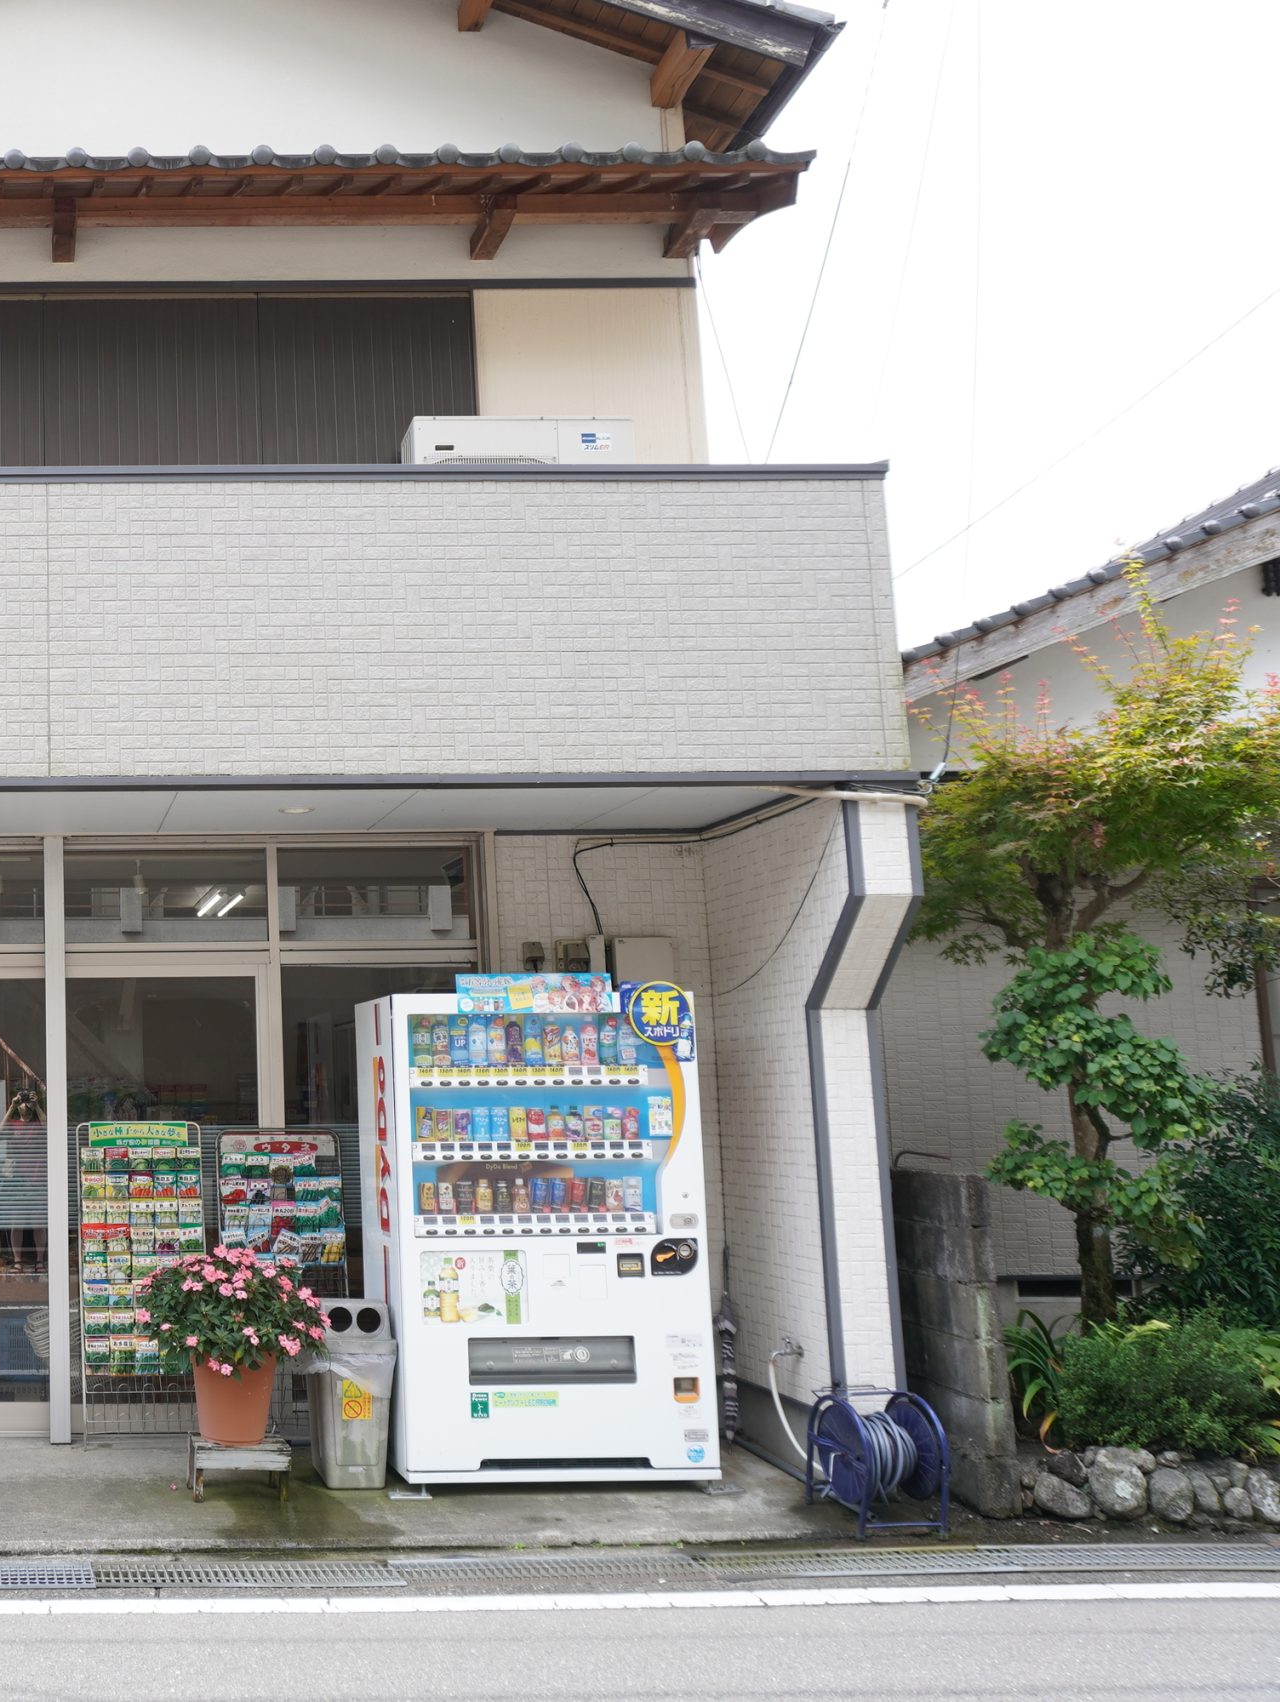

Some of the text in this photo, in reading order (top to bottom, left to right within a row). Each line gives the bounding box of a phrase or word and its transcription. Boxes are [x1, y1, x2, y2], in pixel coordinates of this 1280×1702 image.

[641, 989, 680, 1026] 新
[454, 1039, 466, 1047] UP
[644, 1026, 680, 1037] スポドリ
[378, 1056, 391, 1233] DyDo
